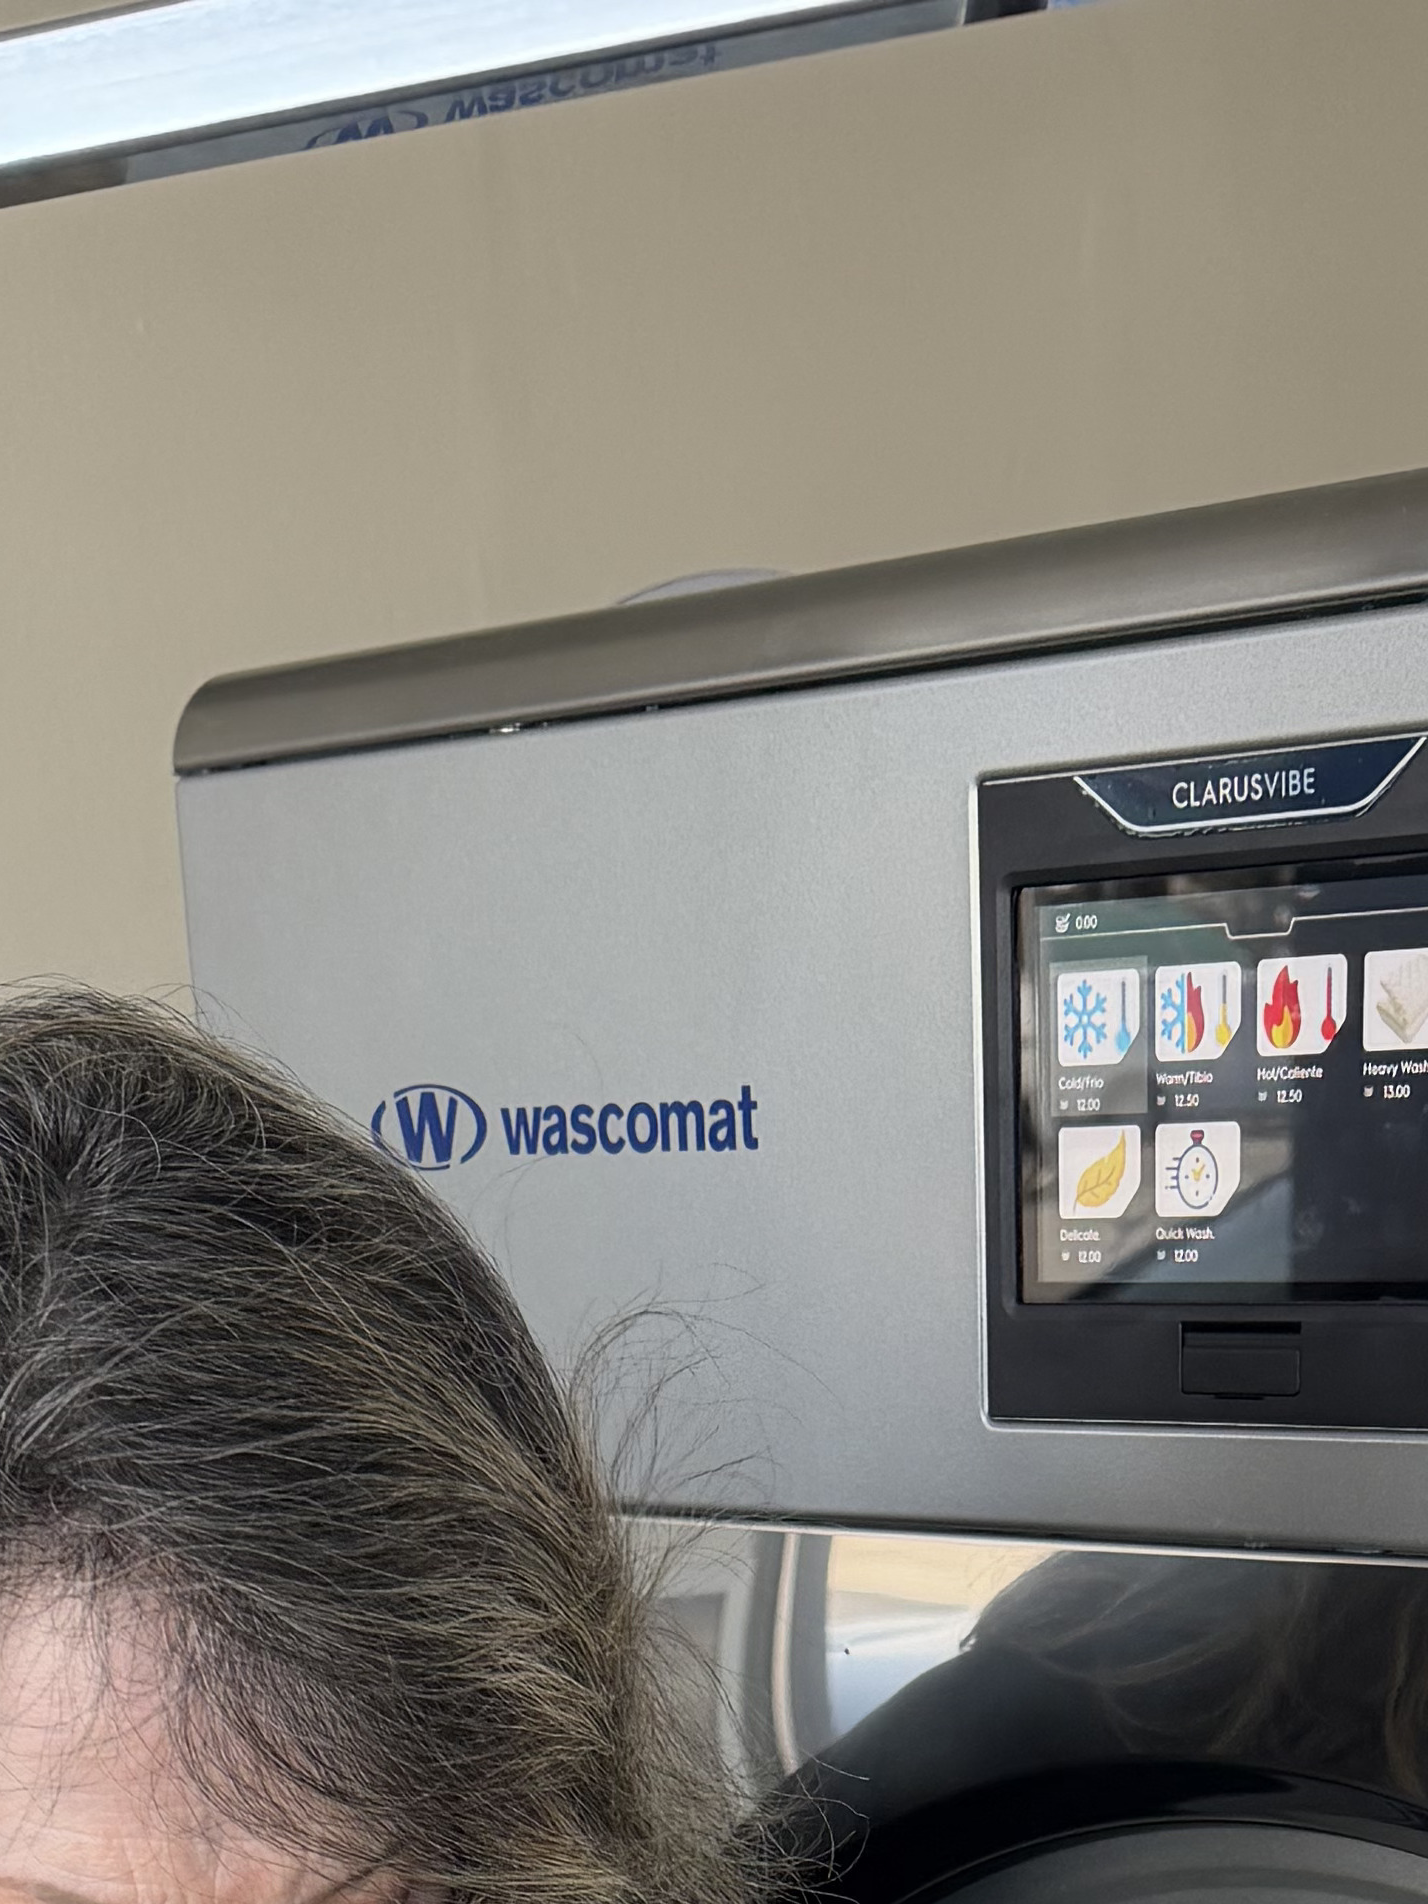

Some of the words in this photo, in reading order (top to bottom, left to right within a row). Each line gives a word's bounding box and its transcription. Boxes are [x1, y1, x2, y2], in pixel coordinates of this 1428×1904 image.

[1172, 767, 1316, 809] CLARUSVIBE
[1075, 914, 1098, 930] 0.00
[1362, 1062, 1398, 1078] Heavy
[1276, 1089, 1303, 1104] 12.50
[1383, 1084, 1411, 1099] 13.00
[1076, 1098, 1101, 1112] 12.00
[1174, 1094, 1200, 1108] 12.50
[395, 1091, 459, 1164] W
[500, 1084, 759, 1156] wascomat
[1155, 1227, 1185, 1241] Quick
[1078, 1250, 1102, 1264] 12.00
[1174, 1249, 1199, 1264] 12.00
